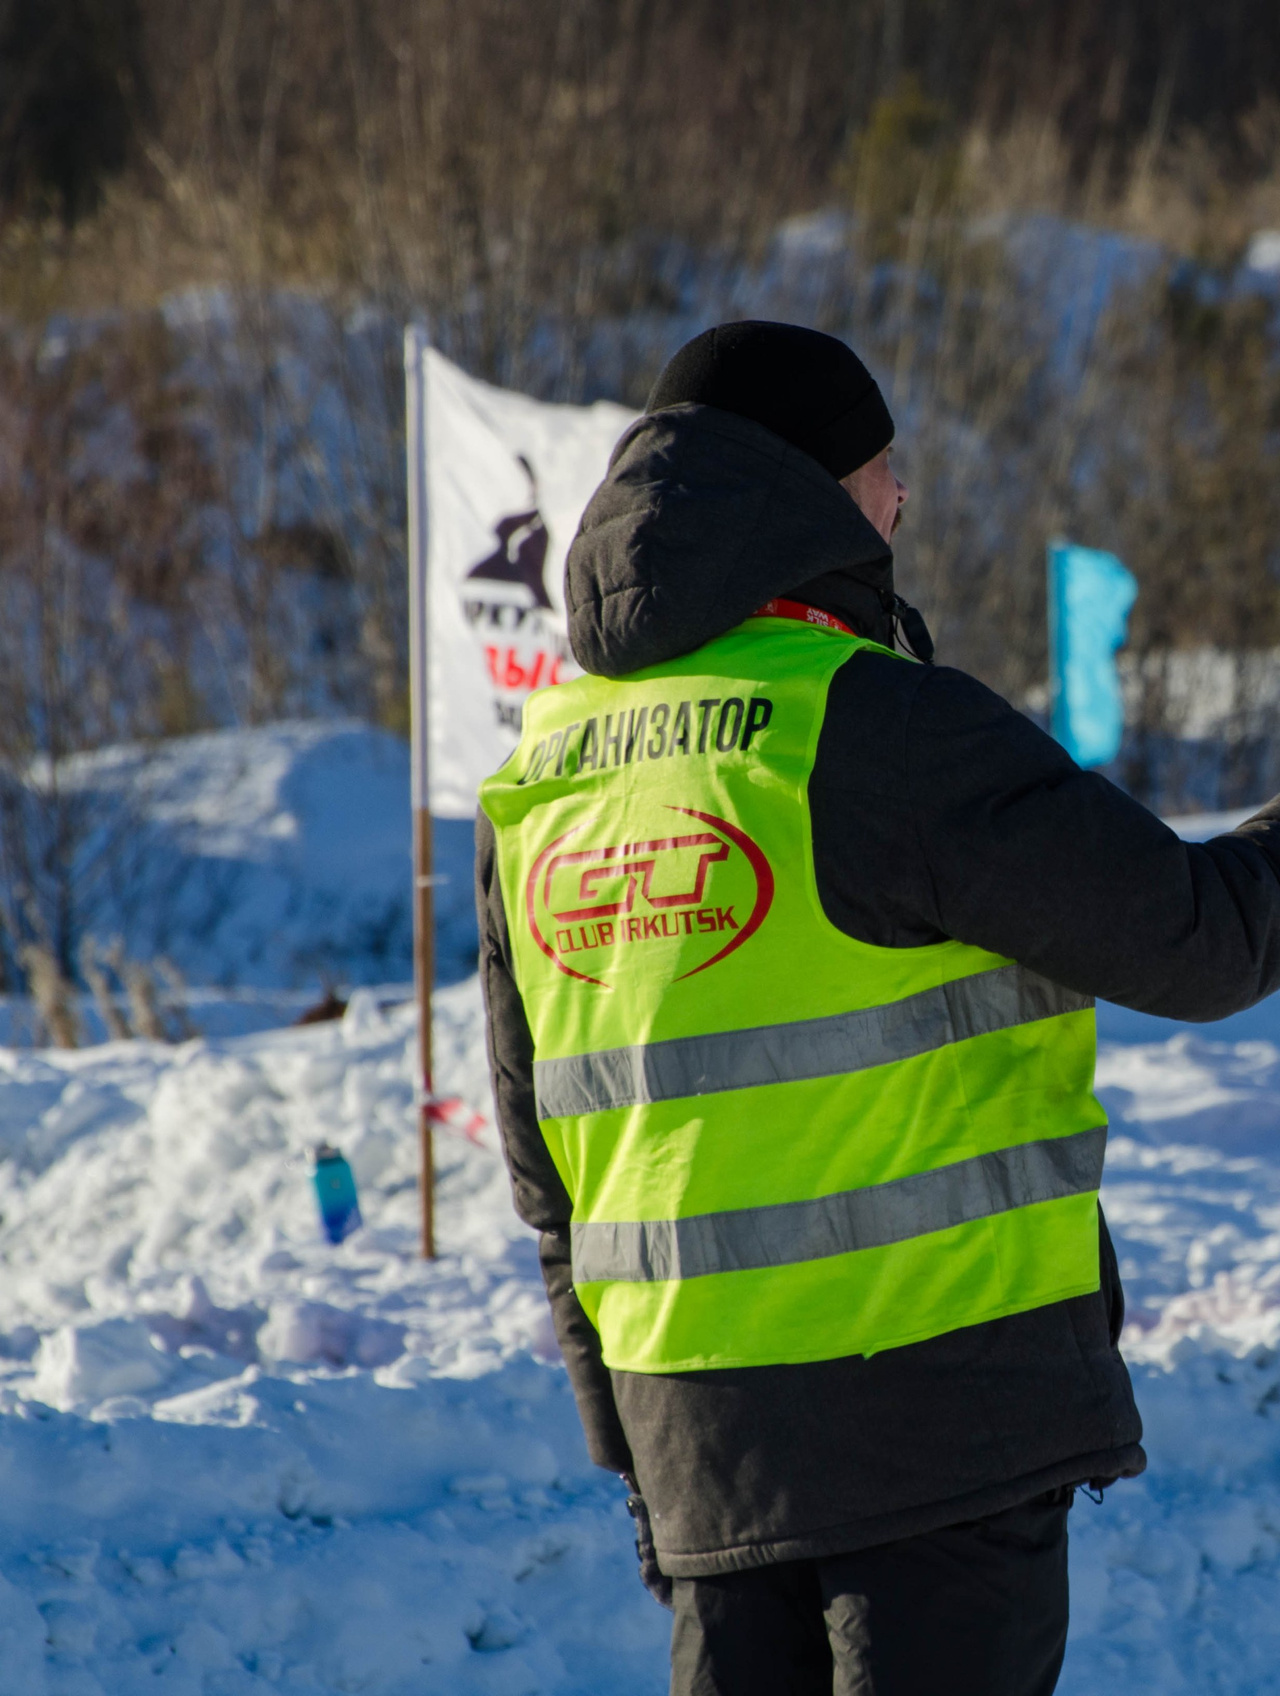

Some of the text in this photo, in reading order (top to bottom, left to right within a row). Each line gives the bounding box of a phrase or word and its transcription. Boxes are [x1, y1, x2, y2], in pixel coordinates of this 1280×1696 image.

[806, 607, 829, 622] WAY
[518, 697, 774, 786] ОРГАНИЗАТОР
[543, 832, 730, 924] GT
[555, 905, 740, 954] CLUB IRKUTSK
